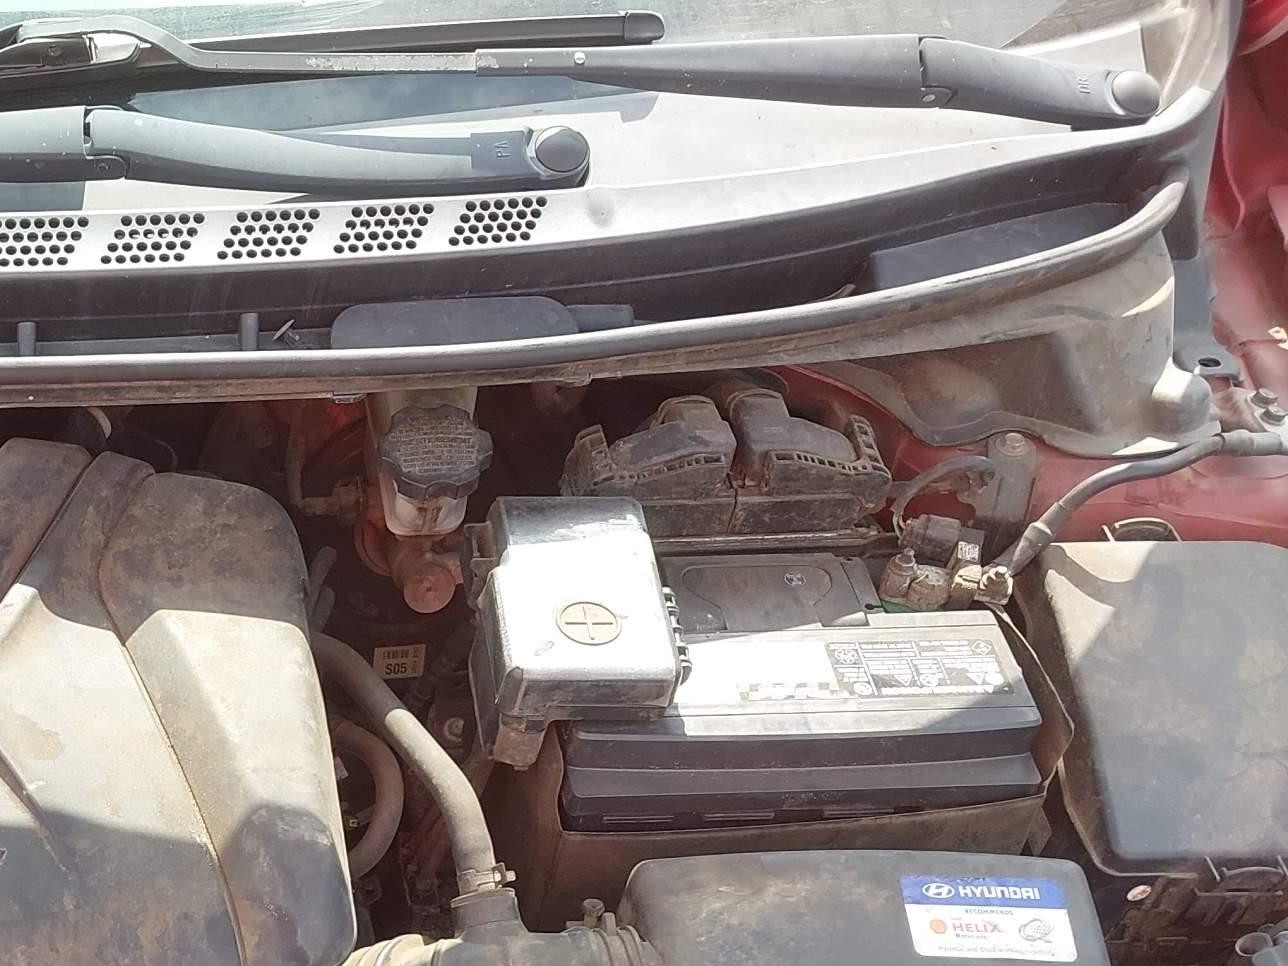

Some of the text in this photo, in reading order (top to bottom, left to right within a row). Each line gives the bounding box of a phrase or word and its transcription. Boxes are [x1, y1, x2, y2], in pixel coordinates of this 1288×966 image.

[493, 140, 512, 159] PA
[384, 662, 408, 675] S05
[957, 886, 1041, 900] HYUNDAI
[952, 921, 1002, 933] HELIX
